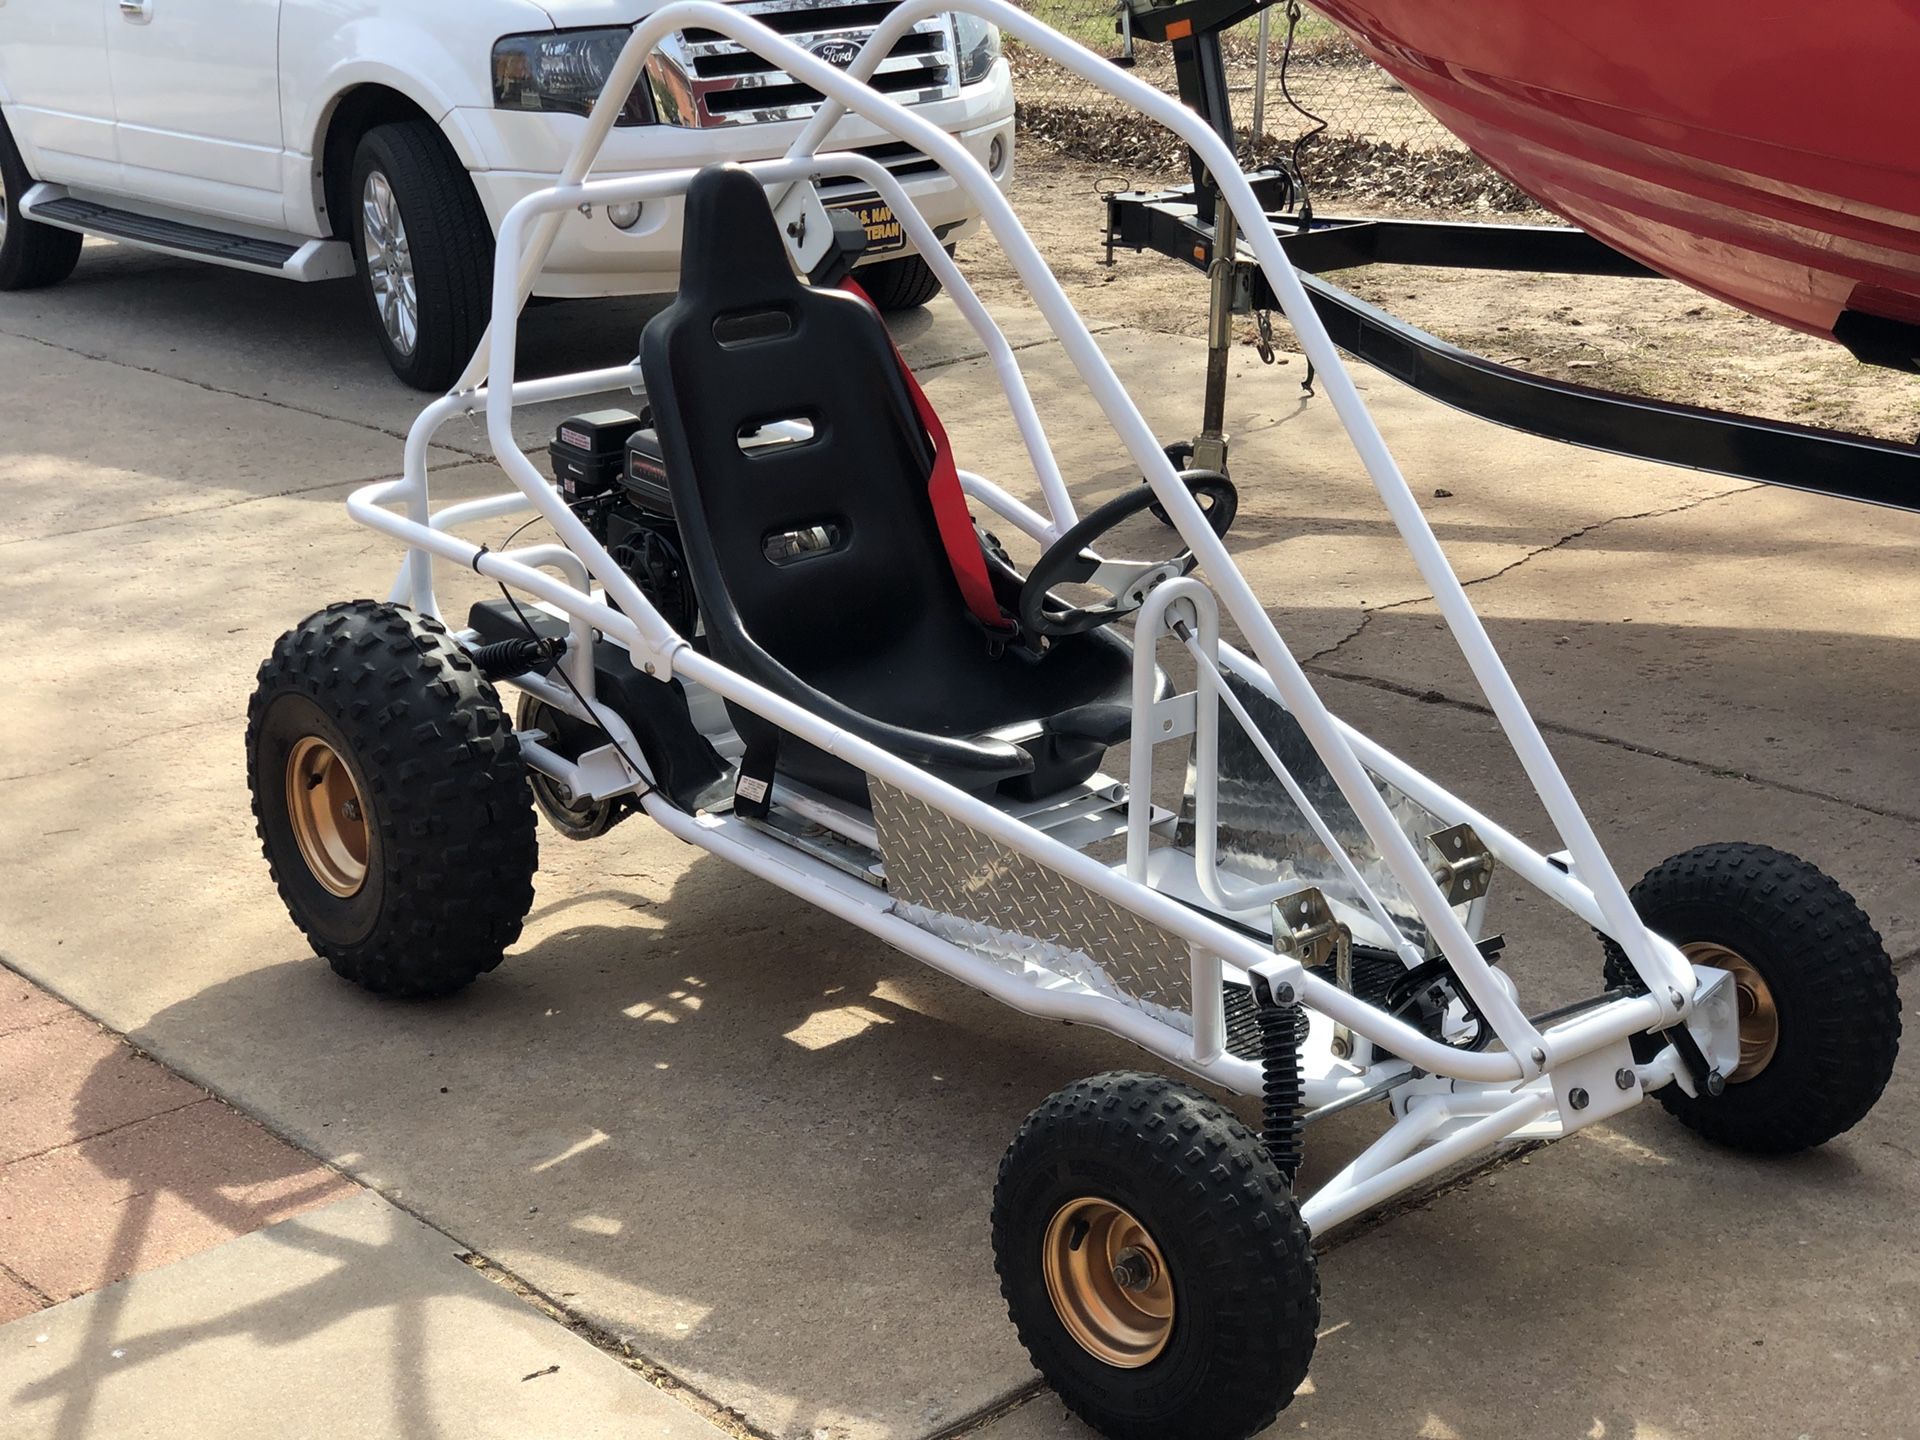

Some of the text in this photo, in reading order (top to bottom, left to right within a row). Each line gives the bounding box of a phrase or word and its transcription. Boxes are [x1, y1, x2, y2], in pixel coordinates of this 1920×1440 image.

[822, 44, 854, 63] Ford
[872, 206, 892, 223] NAV
[864, 222, 899, 241] TERAN
